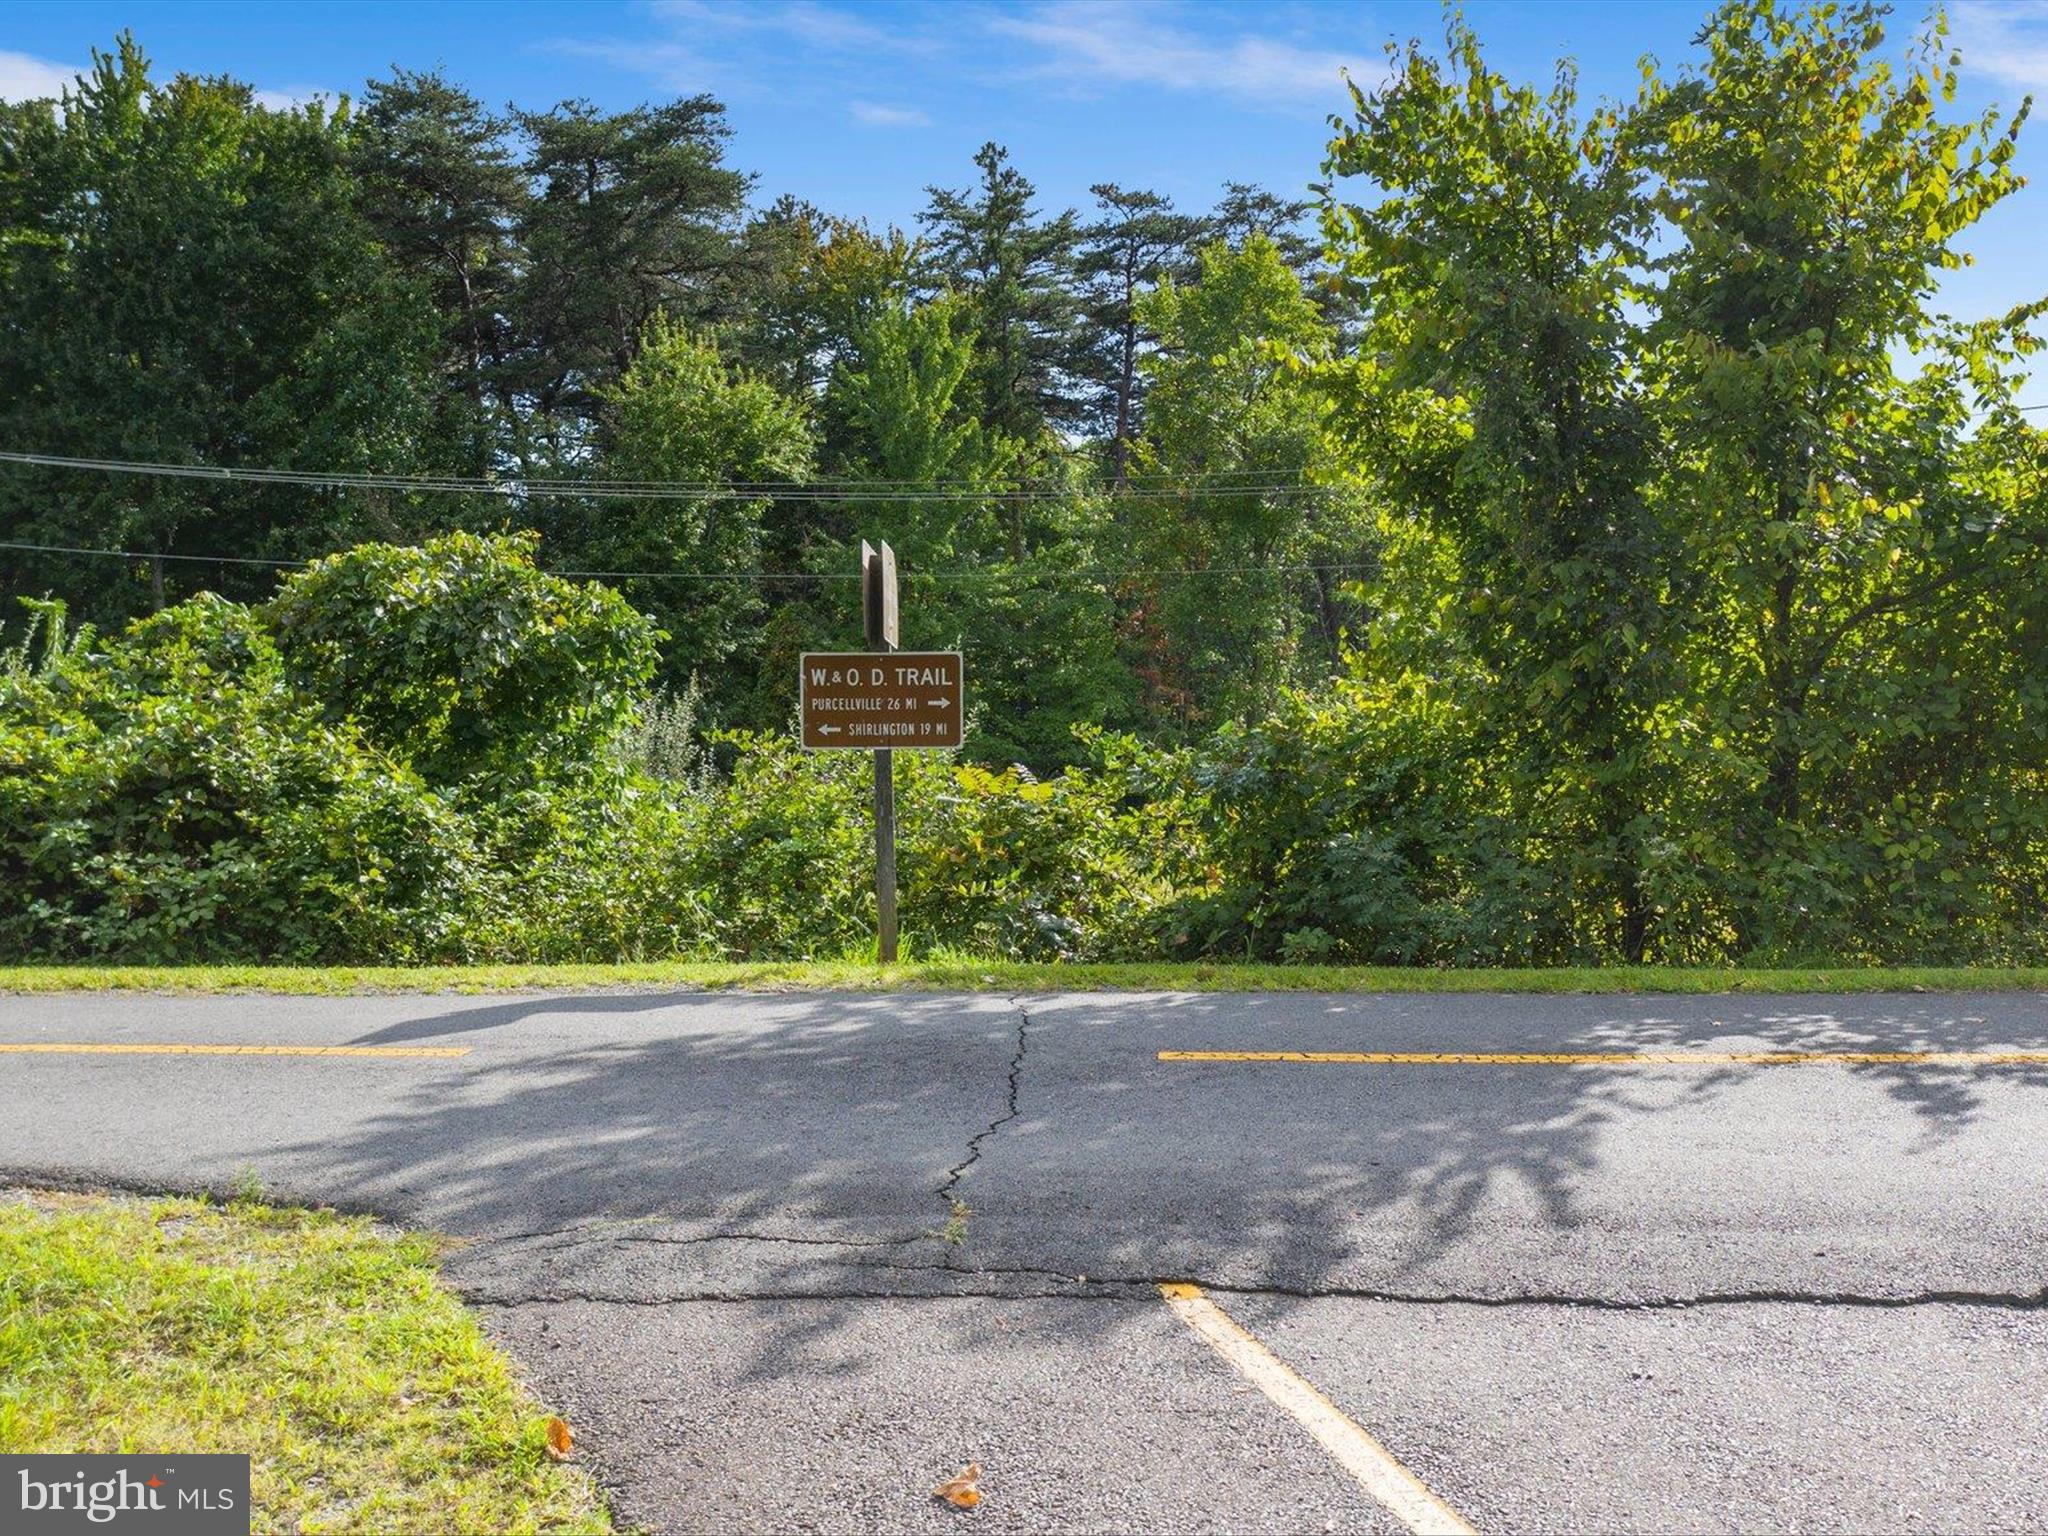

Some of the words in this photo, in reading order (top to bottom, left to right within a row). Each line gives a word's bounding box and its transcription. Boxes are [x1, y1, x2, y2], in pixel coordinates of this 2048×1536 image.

[811, 668, 831, 687] W.
[832, 671, 842, 684] &
[846, 668, 863, 686] O.
[871, 668, 887, 686] D.
[895, 668, 953, 686] TRAIL
[812, 697, 882, 711] PURCELLVILLE
[887, 698, 901, 710] 26
[906, 698, 917, 710] MI
[849, 723, 915, 736] SHIRLINGTON
[920, 723, 931, 735] 19
[936, 723, 947, 735] MI
